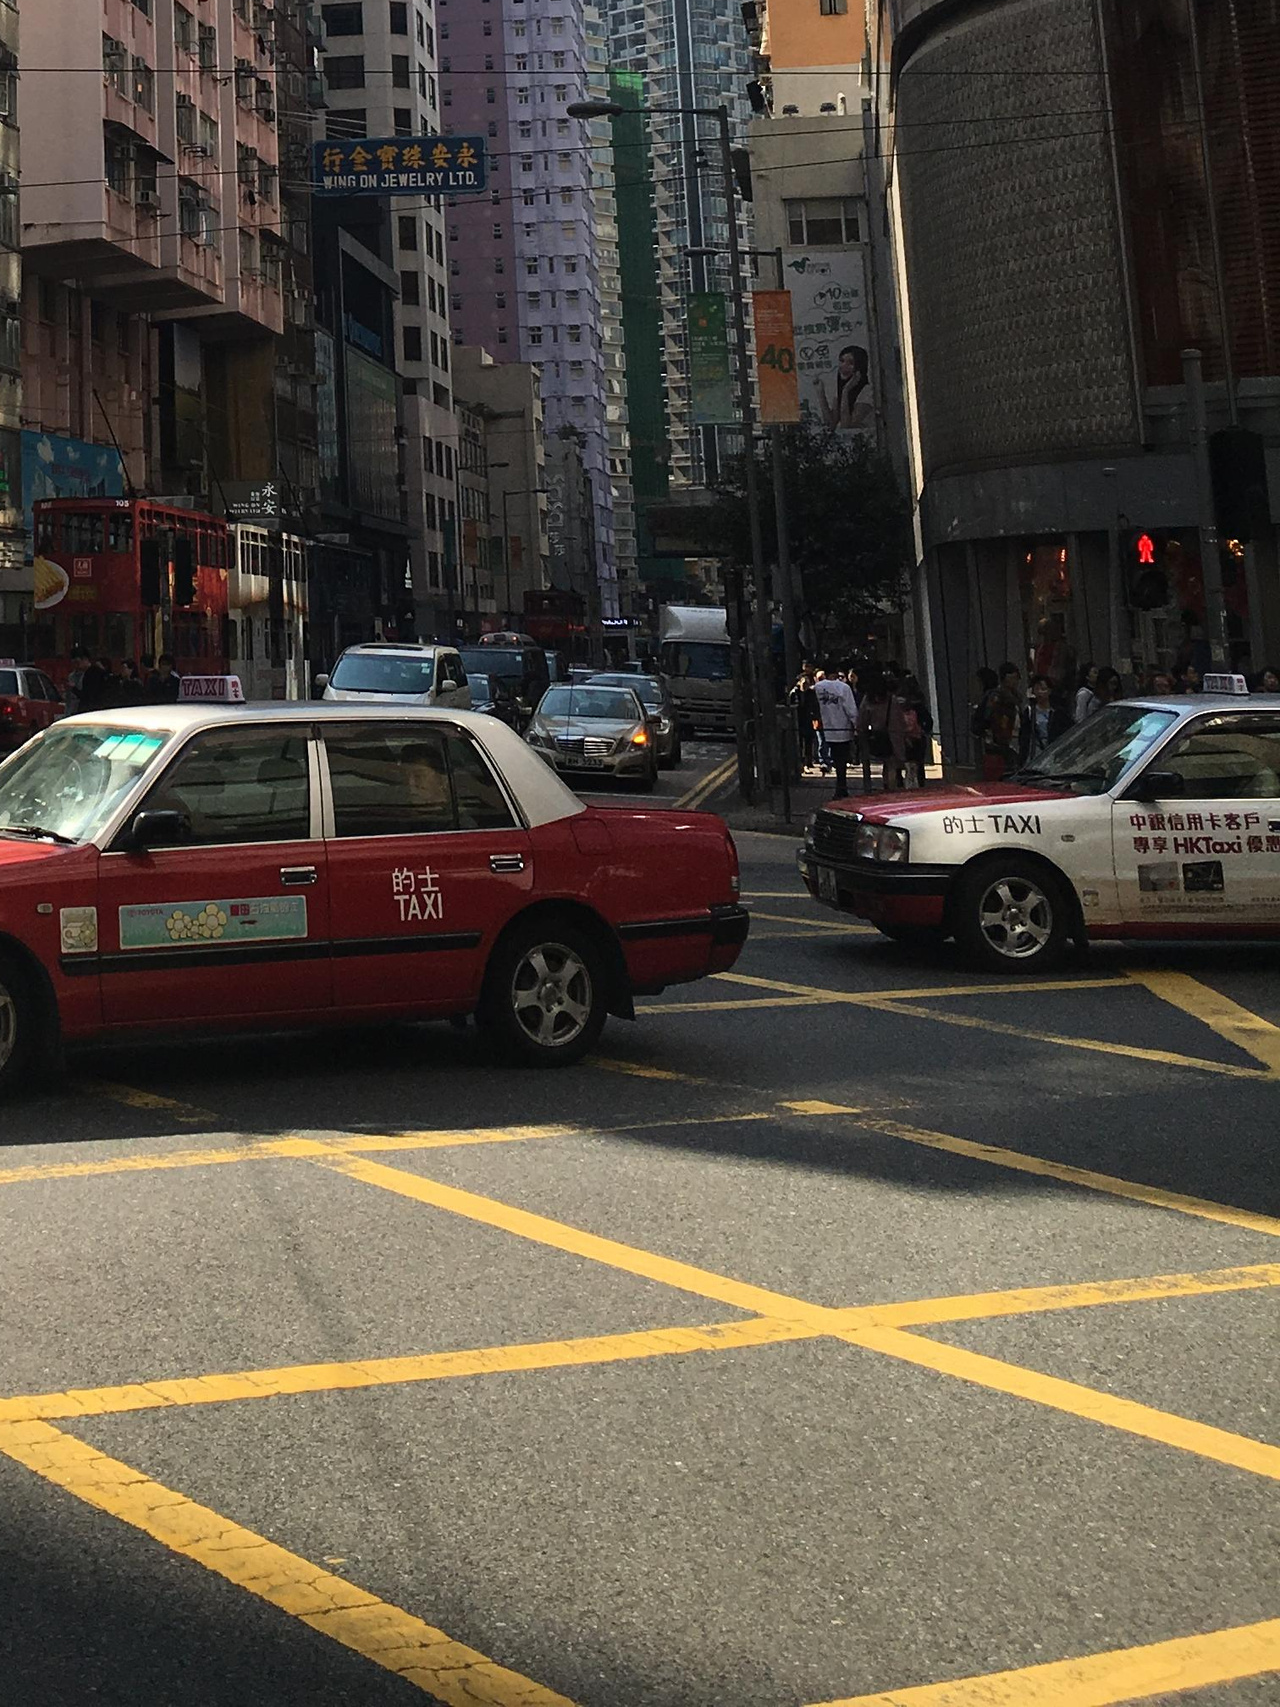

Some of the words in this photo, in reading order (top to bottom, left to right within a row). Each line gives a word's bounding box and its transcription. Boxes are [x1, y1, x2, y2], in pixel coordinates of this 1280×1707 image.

[322, 141, 479, 174] 永安珠寶金行
[323, 175, 356, 190] WING
[359, 174, 378, 189] ON
[380, 172, 444, 188] JEWELRY
[448, 170, 478, 186] LTD.
[759, 344, 795, 374] 40
[261, 481, 278, 515] 永安
[181, 678, 226, 697] TAXI
[942, 814, 986, 835] 的士
[987, 814, 1043, 835] TAXI
[1129, 811, 1262, 832] 中銀信用卡客戶
[1133, 834, 1168, 855] 專享
[1173, 834, 1243, 855] HKTaxi
[391, 865, 441, 894] 的士
[392, 892, 444, 922] TAXI
